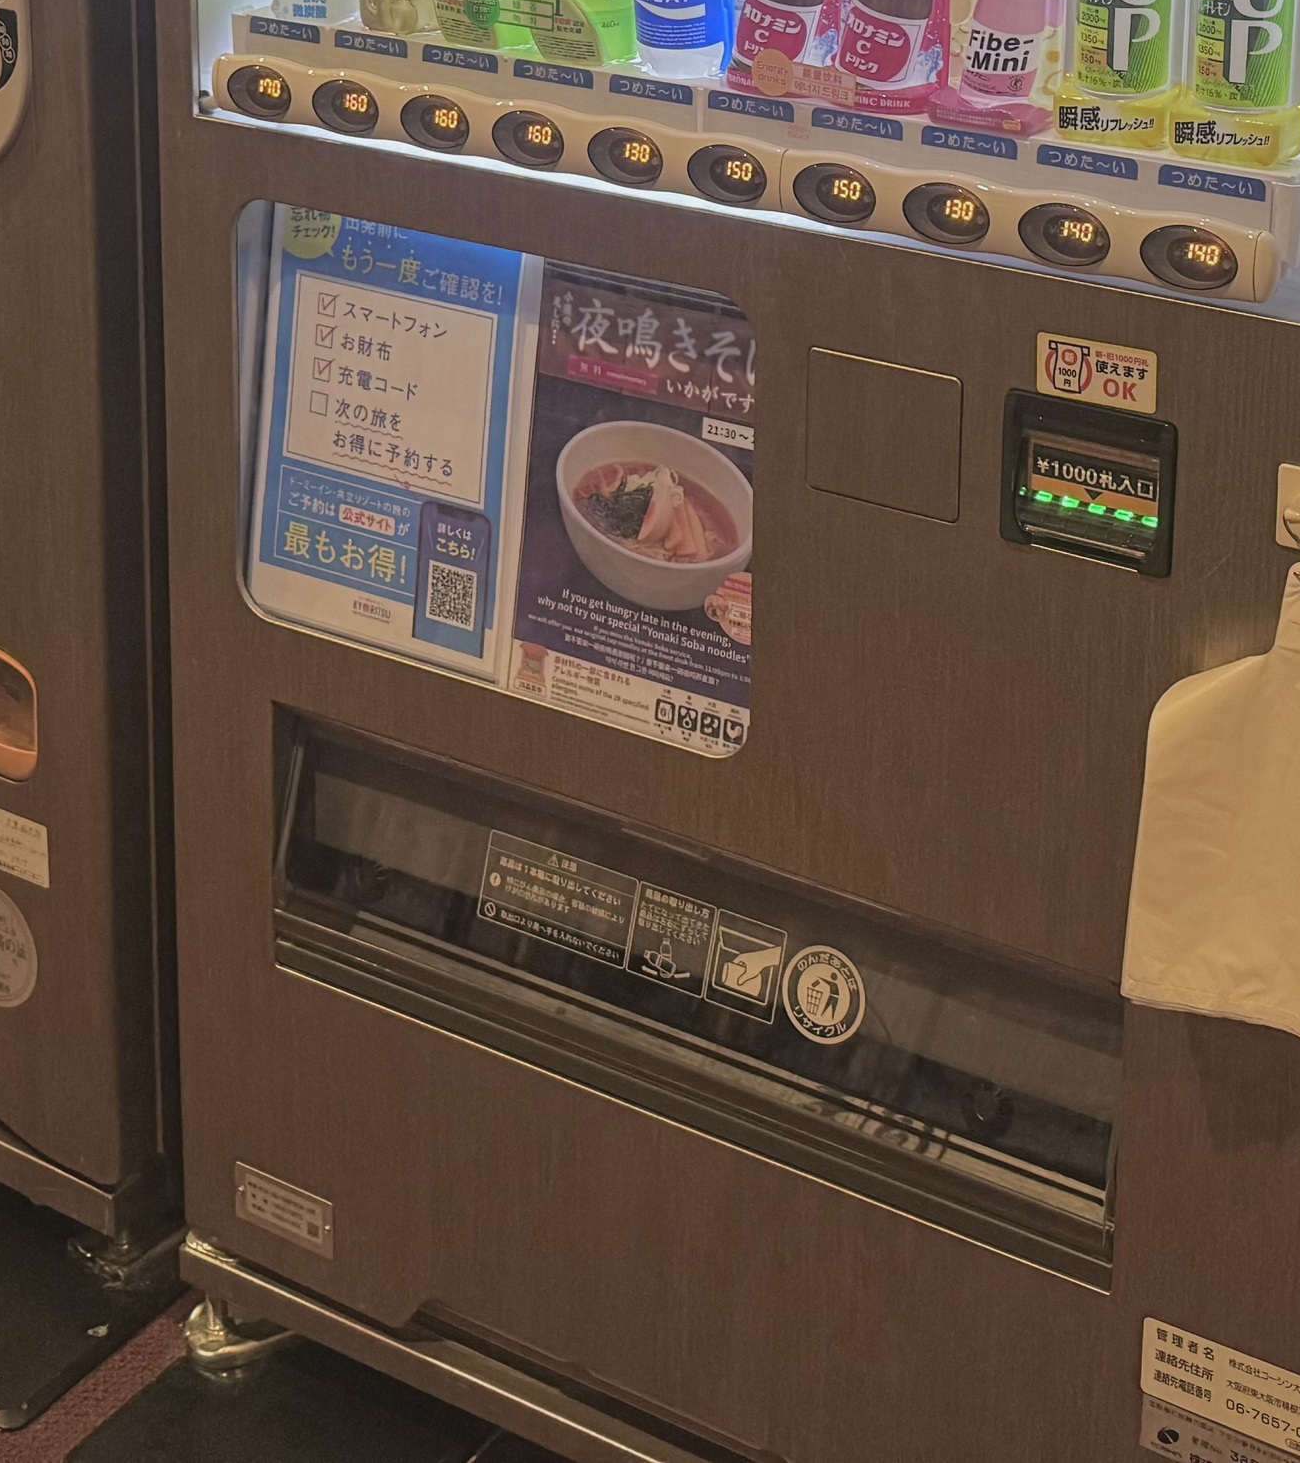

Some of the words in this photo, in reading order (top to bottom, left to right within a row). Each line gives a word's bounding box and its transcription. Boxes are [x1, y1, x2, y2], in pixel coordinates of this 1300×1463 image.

[847, 15, 905, 47] オロナミン
[756, 61, 789, 76] Energy
[756, 73, 787, 86] drinks
[258, 78, 282, 98] 170
[343, 92, 368, 114] 160
[624, 141, 651, 163] 130
[832, 178, 861, 201] 150
[945, 198, 975, 221] 130
[1187, 242, 1221, 266] 140
[341, 244, 504, 306] もう一度ご確認を!
[343, 301, 447, 339] スマートフォン
[340, 333, 392, 361] お財布
[571, 299, 755, 386] 夜鳴きそ
[338, 366, 418, 400] 充電コード
[1056, 366, 1078, 380] 1000
[1095, 359, 1149, 381] 使えます
[1102, 378, 1138, 403] OK
[335, 397, 401, 433] 次の旅を
[333, 430, 453, 479] お得に予約する
[1036, 455, 1157, 500] ¥1000札入口
[437, 522, 472, 542] 詳しくは
[284, 523, 405, 584] 最もお得!
[537, 595, 556, 612] why
[557, 601, 574, 616] not
[575, 606, 589, 620] try
[590, 611, 606, 623] our
[607, 613, 640, 634] special
[681, 636, 705, 653] Soba
[570, 592, 588, 606] you
[588, 596, 604, 610] get
[605, 599, 639, 621] hungry
[640, 610, 659, 625] late
[672, 619, 688, 633] the
[690, 627, 732, 648] evening,
[793, 1004, 847, 1037] リサイクル
[1157, 1327, 1215, 1361] 管理者名
[1155, 1348, 1214, 1382] 連絡先住所
[1154, 1369, 1212, 1402] 連絡先電話番号
